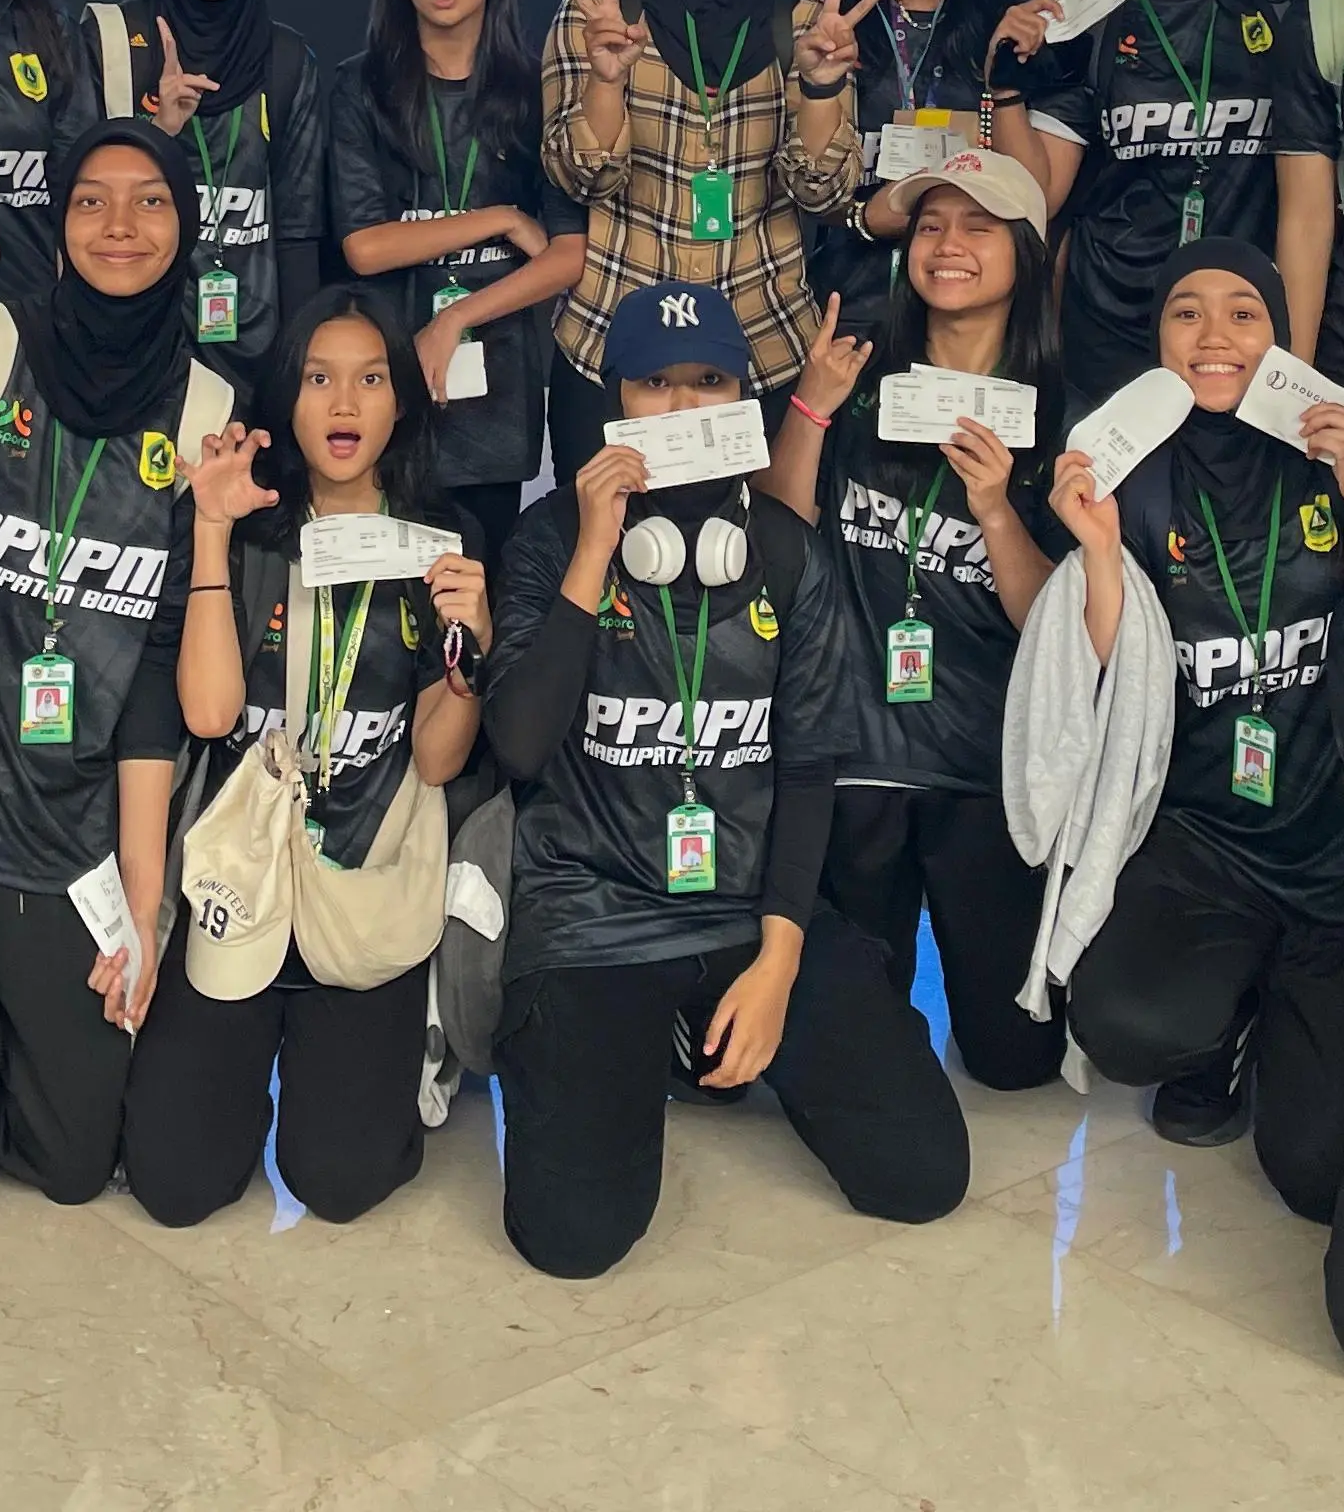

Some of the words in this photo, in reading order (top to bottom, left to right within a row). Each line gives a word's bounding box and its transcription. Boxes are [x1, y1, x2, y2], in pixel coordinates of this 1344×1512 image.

[598, 616, 636, 632] spora
[720, 744, 773, 769] BOGO
[196, 879, 252, 920] NINETEEN
[199, 898, 229, 940] 19
